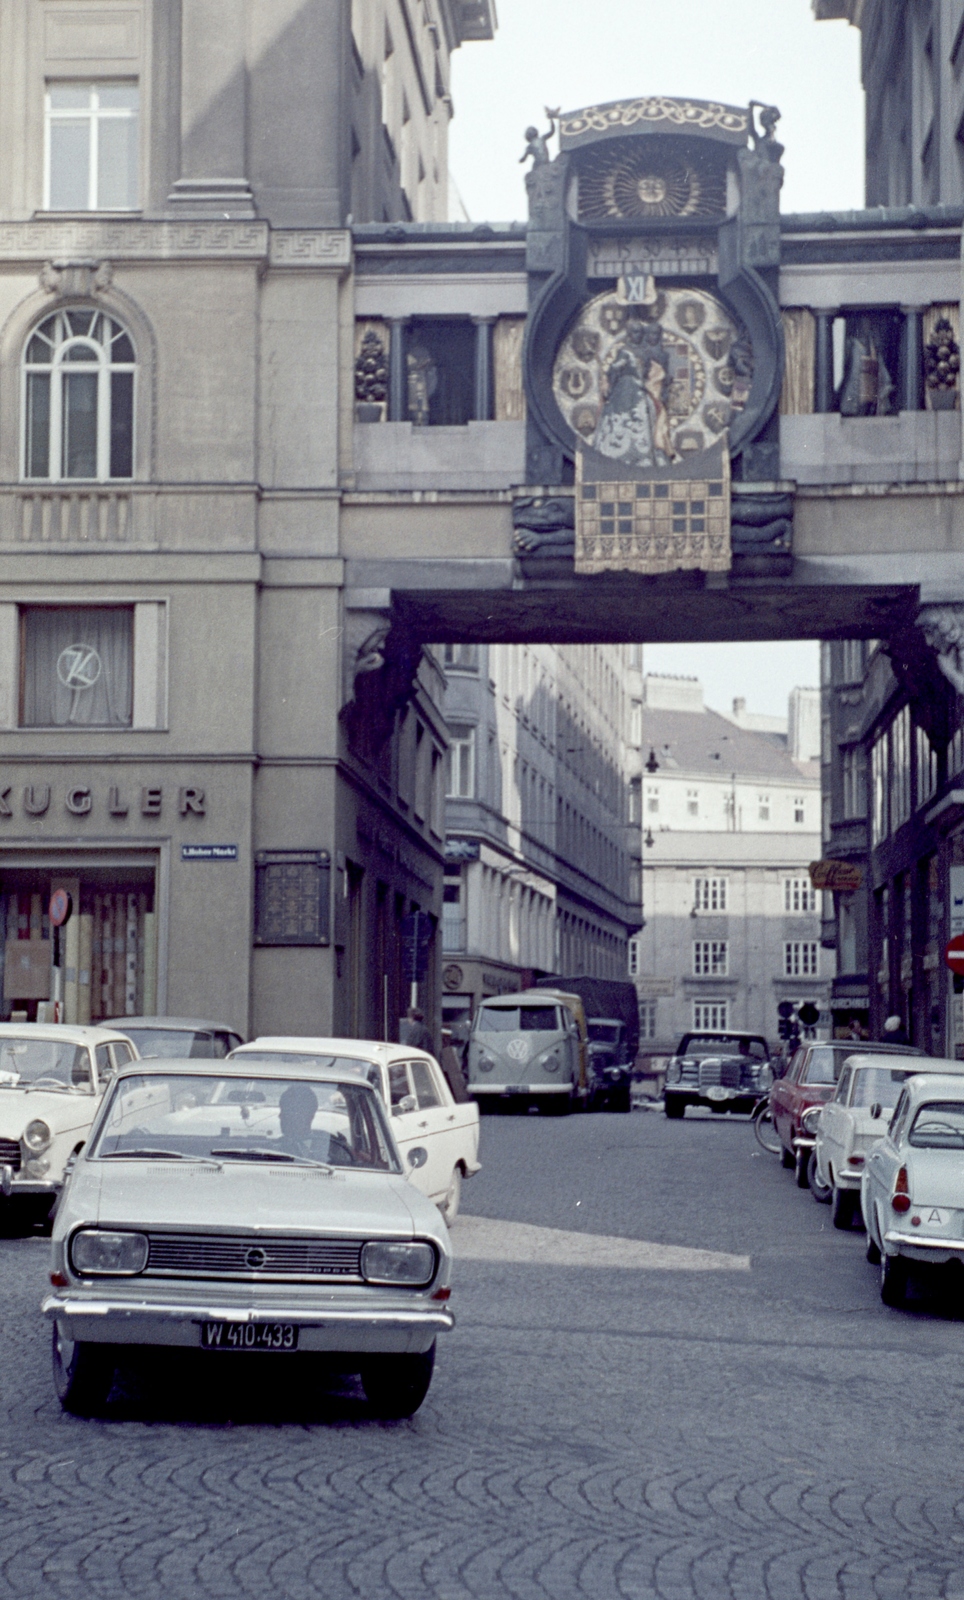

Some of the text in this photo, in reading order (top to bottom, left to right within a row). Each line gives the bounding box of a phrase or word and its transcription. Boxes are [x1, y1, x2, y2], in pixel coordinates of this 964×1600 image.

[627, 275, 645, 302] XI
[212, 847, 236, 857] Markt
[508, 1039, 528, 1060] VW
[927, 1208, 942, 1224] A
[313, 1266, 350, 1274] OPEL
[207, 1323, 223, 1346] W
